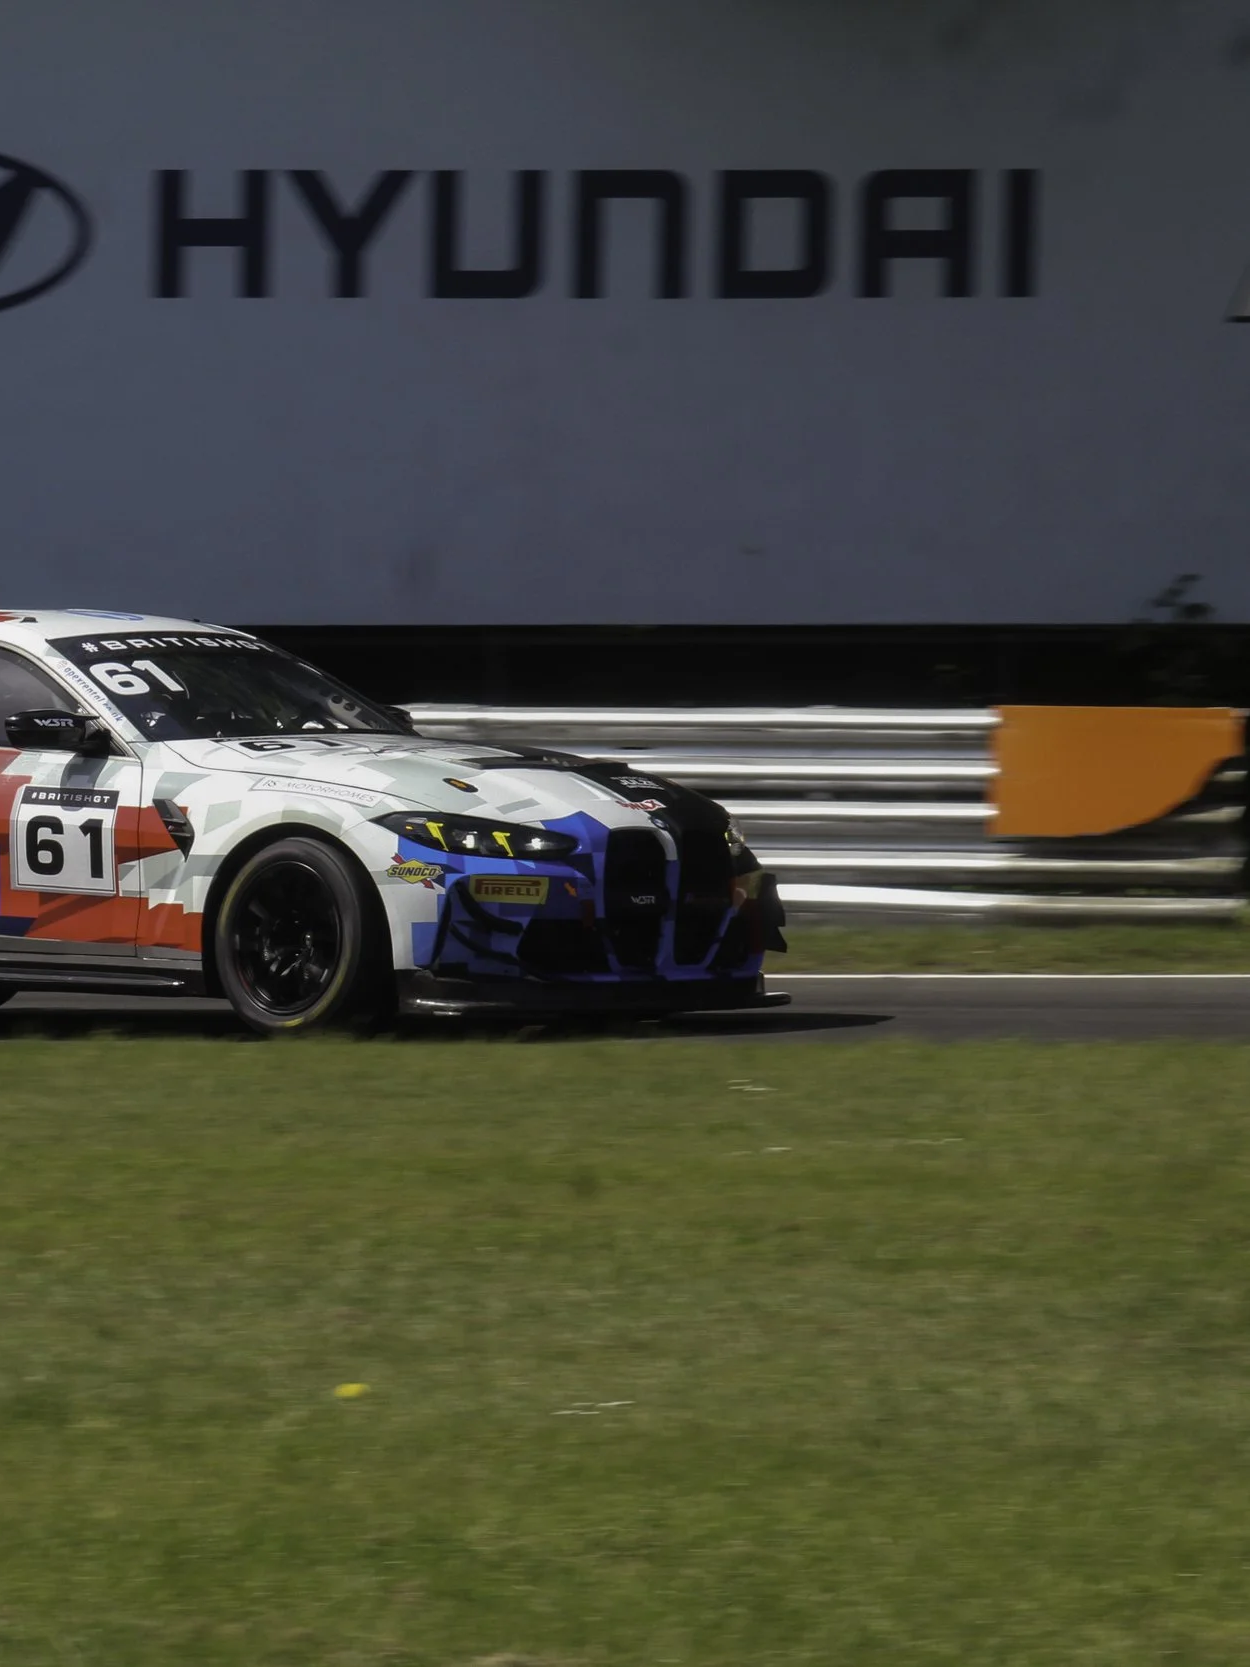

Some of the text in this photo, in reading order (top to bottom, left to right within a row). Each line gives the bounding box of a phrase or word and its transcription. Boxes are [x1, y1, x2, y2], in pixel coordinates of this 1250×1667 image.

[153, 169, 1042, 298] HYUNDAI
[81, 636, 274, 653] #BRITISHGT
[89, 660, 184, 695] 61
[34, 718, 74, 727] WSR
[239, 740, 343, 752] 61
[31, 791, 110, 804] #BRITISHGT
[285, 781, 376, 803] MOTORHOMES
[25, 815, 104, 879] 61
[390, 866, 438, 877] SUNOCO
[475, 878, 541, 898] PIRELLI
